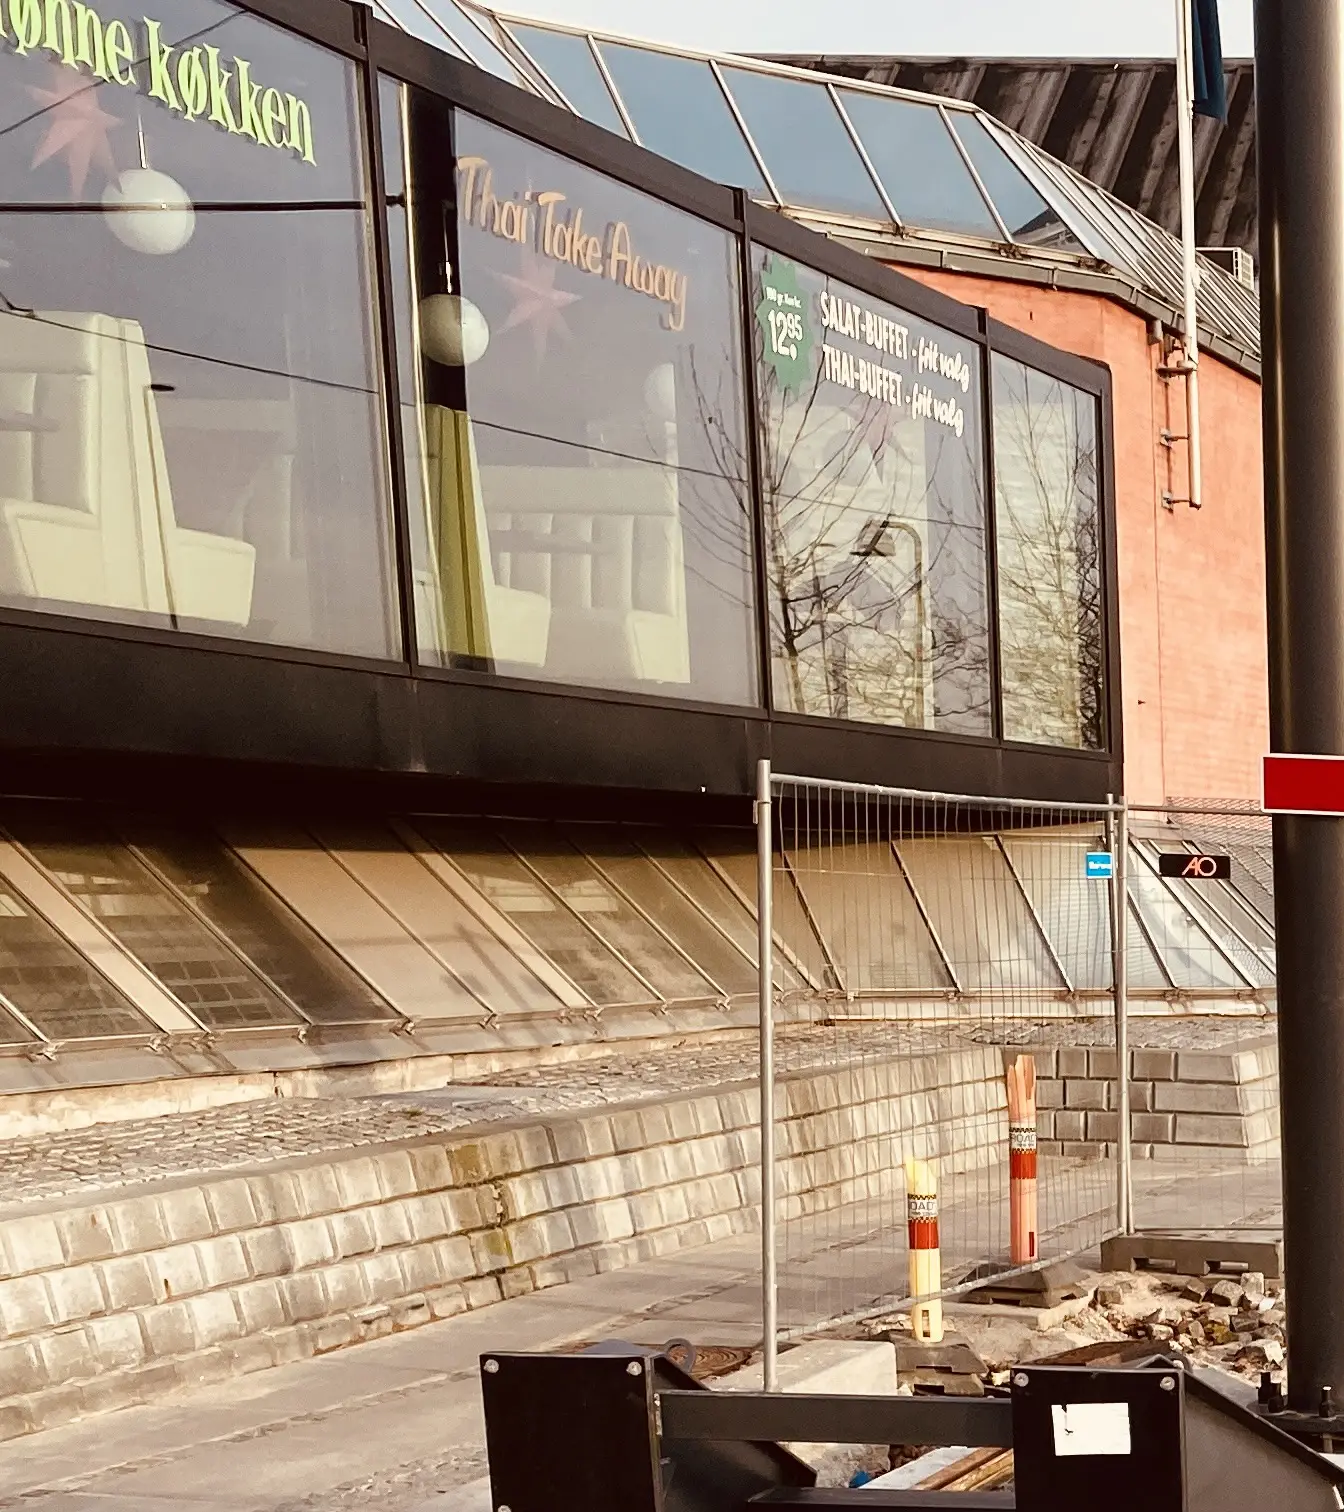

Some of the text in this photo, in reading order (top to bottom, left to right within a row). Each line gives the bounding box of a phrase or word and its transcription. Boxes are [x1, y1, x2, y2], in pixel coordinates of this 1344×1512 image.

[0, 0, 318, 167] ønne køkken
[457, 157, 688, 331] Thai Take Away
[820, 291, 909, 360] SALAT-BUFFET
[939, 352, 970, 393] valg
[822, 343, 903, 406] THAI-BUFFET
[1181, 856, 1217, 877] AO
